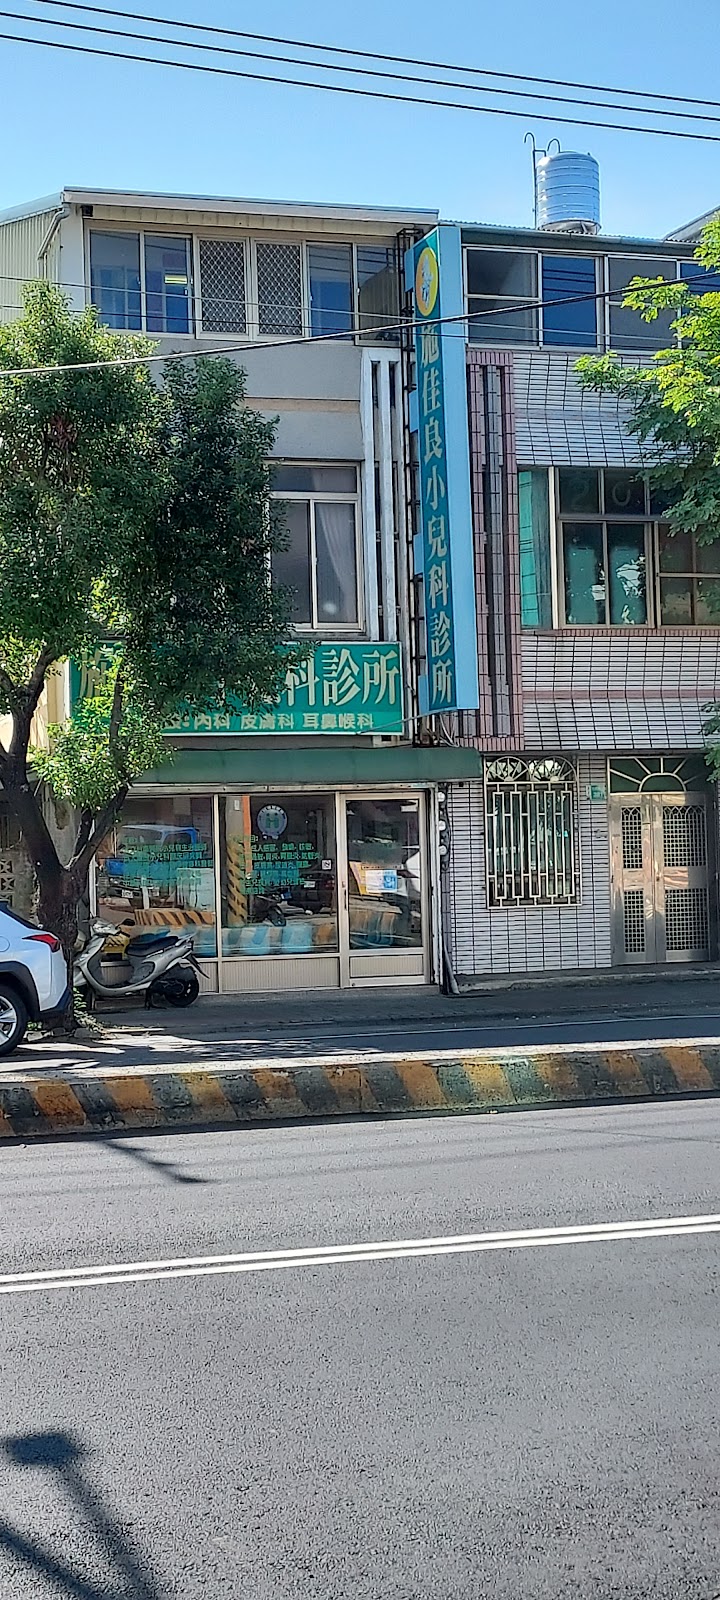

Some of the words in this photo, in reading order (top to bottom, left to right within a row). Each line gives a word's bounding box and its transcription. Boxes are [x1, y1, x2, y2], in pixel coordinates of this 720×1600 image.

[420, 322, 453, 705] 施佳良小兒科診所
[240, 713, 294, 730] 皮膚科
[302, 713, 374, 730] 耳鼻喉科
